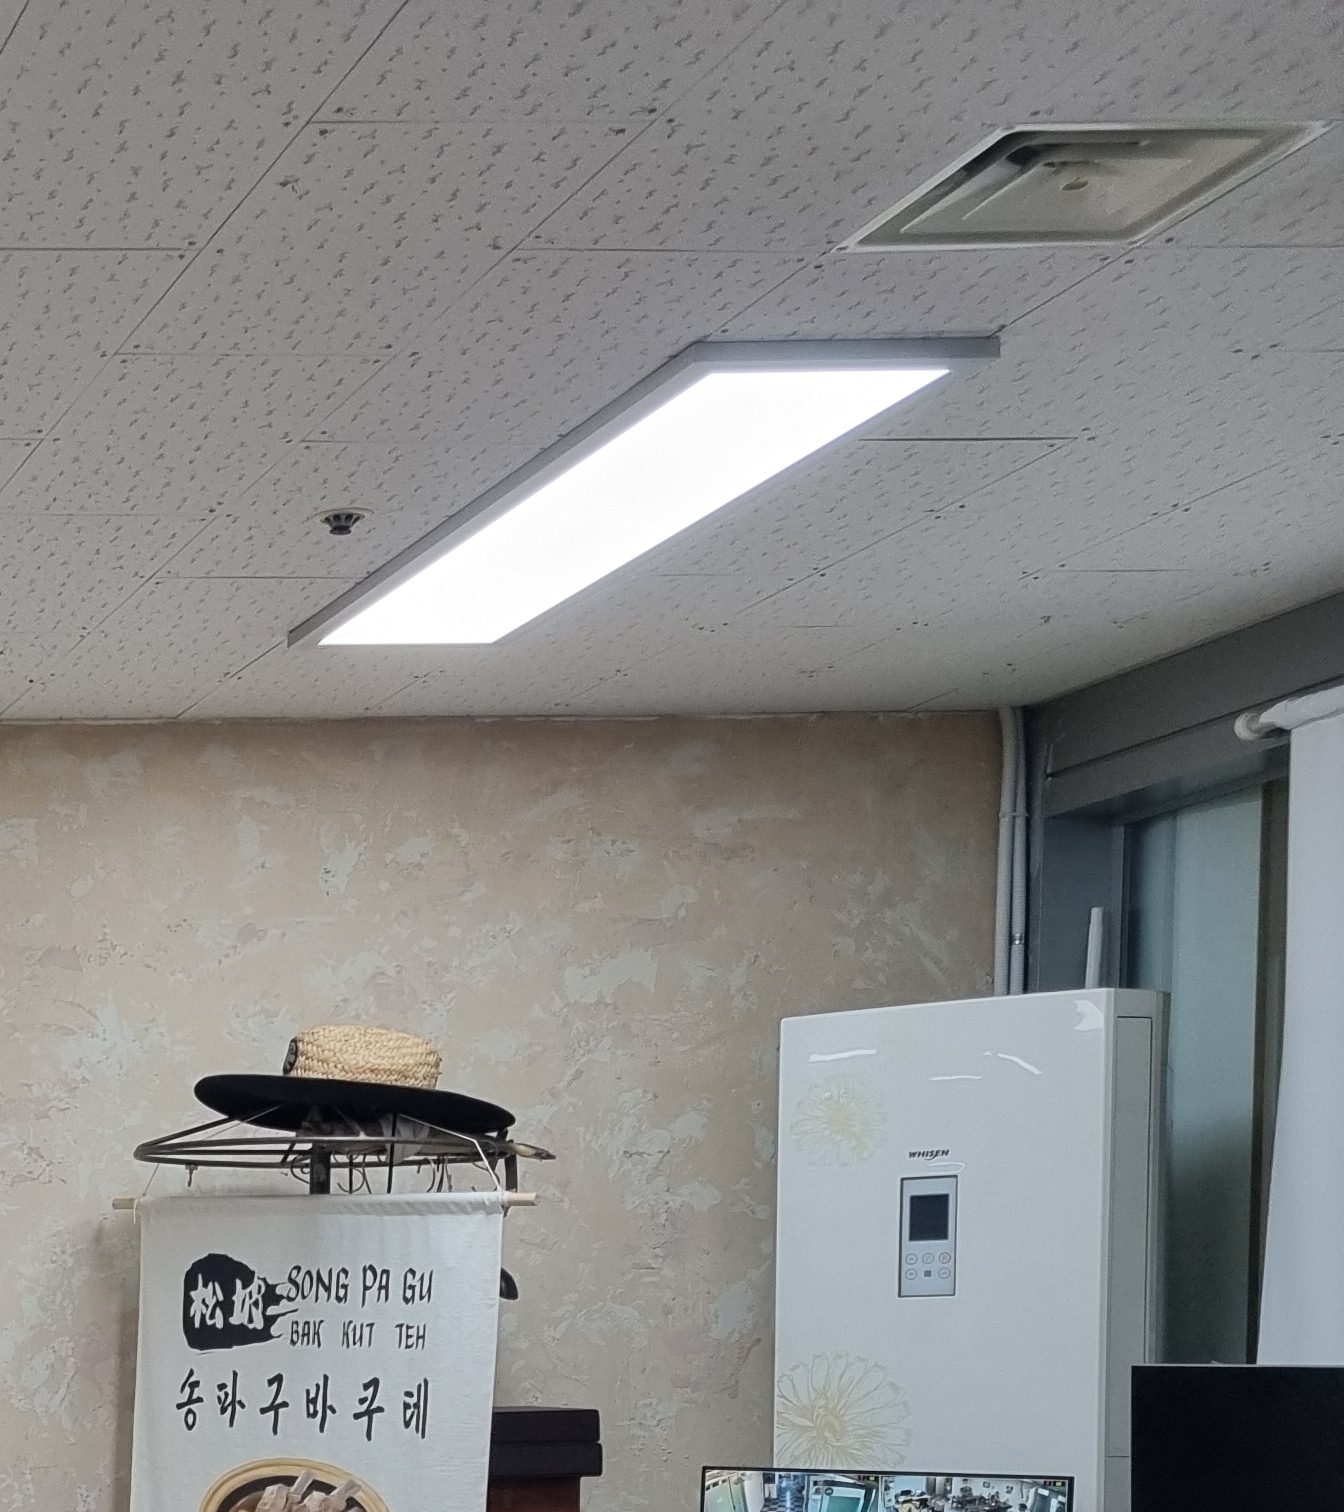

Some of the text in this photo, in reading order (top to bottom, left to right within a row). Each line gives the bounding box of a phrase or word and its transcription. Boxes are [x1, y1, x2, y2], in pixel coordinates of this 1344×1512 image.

[908, 1149, 950, 1161] WHISEN
[287, 1264, 434, 1308] SONG PA GU
[290, 1319, 427, 1350] BAK KUT TEH
